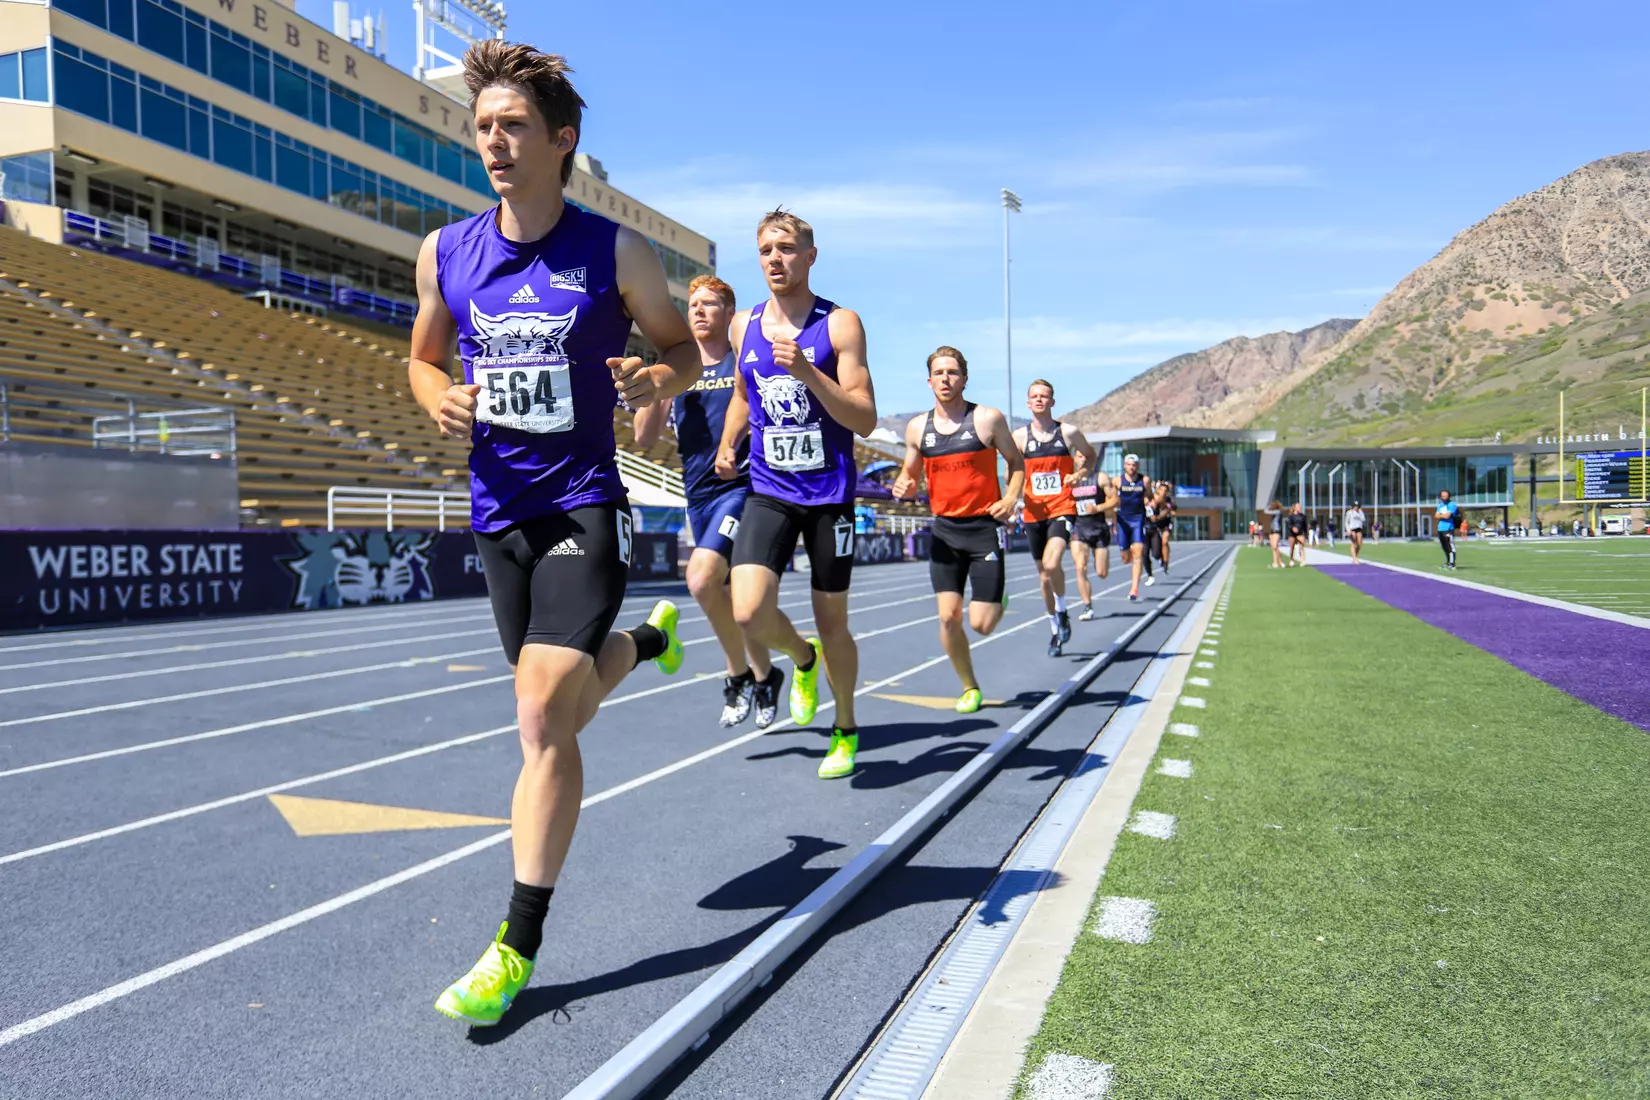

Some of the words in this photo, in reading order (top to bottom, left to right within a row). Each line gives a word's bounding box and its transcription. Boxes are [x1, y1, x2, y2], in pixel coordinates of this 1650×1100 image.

[508, 296, 540, 304] adidas
[487, 370, 557, 416] 564
[687, 376, 737, 391] BCAT
[772, 434, 814, 462] 574
[1537, 433, 1609, 444] ELIABETH
[1035, 476, 1058, 490] 232
[547, 547, 585, 556] adidas
[621, 515, 631, 562] 5
[838, 526, 850, 554] 7
[29, 545, 152, 580] WEBER
[160, 543, 244, 576] STATE
[39, 578, 244, 614] UNIVERSITY
